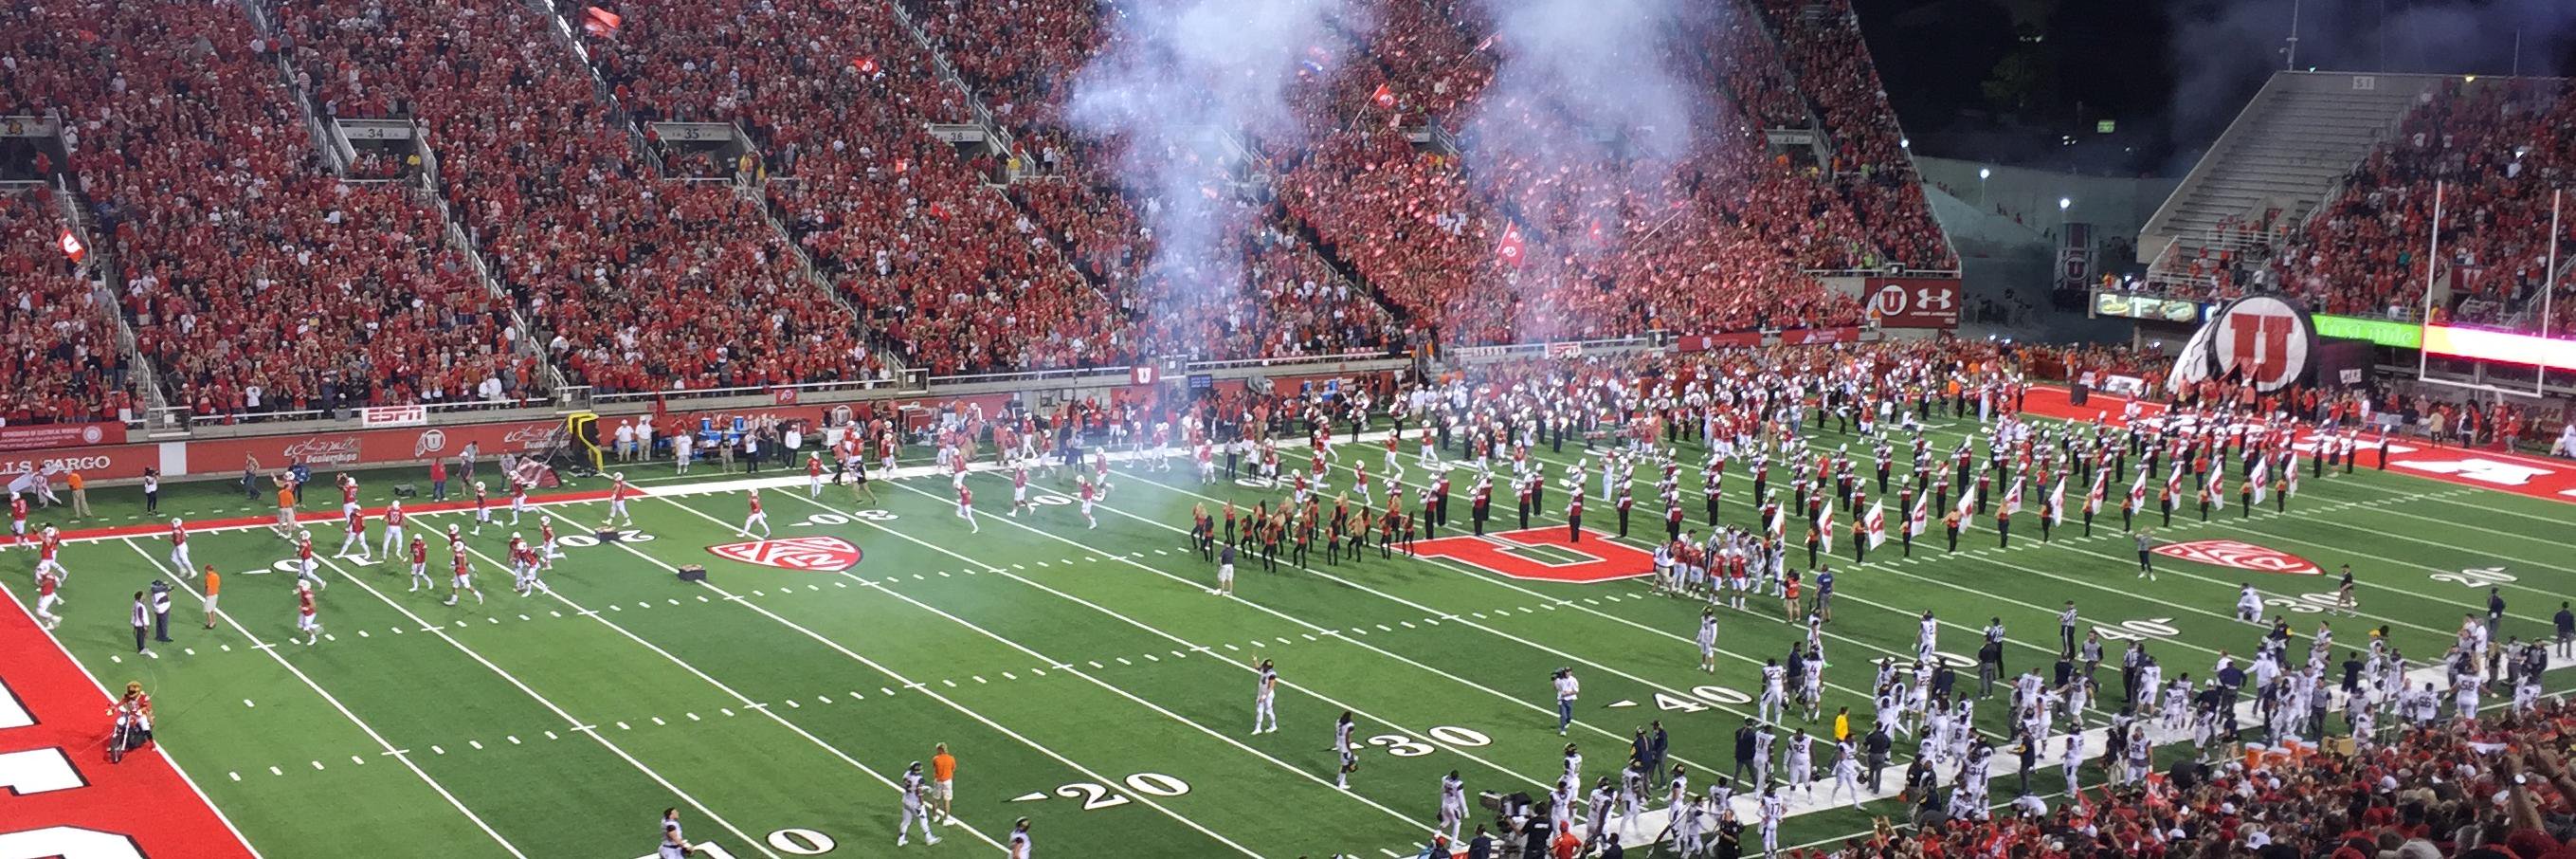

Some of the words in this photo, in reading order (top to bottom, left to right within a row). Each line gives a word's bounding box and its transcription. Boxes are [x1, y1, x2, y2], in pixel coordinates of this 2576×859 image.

[368, 128, 384, 138] 34
[683, 128, 699, 139] 35
[951, 132, 963, 140] 36
[1882, 291, 1902, 312] U
[2230, 313, 2294, 382] U
[1137, 368, 1152, 384] U
[368, 407, 422, 423] ESPN
[45, 455, 111, 473] FARGO
[2091, 619, 2180, 642] 40
[1809, 665, 1818, 676] 4
[2461, 680, 2476, 691] 58
[1652, 685, 1753, 713] 40
[1367, 725, 1492, 757] 30
[1954, 727, 1962, 740] 6
[1758, 737, 1767, 749] 11
[1055, 772, 1192, 811] 20
[1770, 802, 1780, 815] 17
